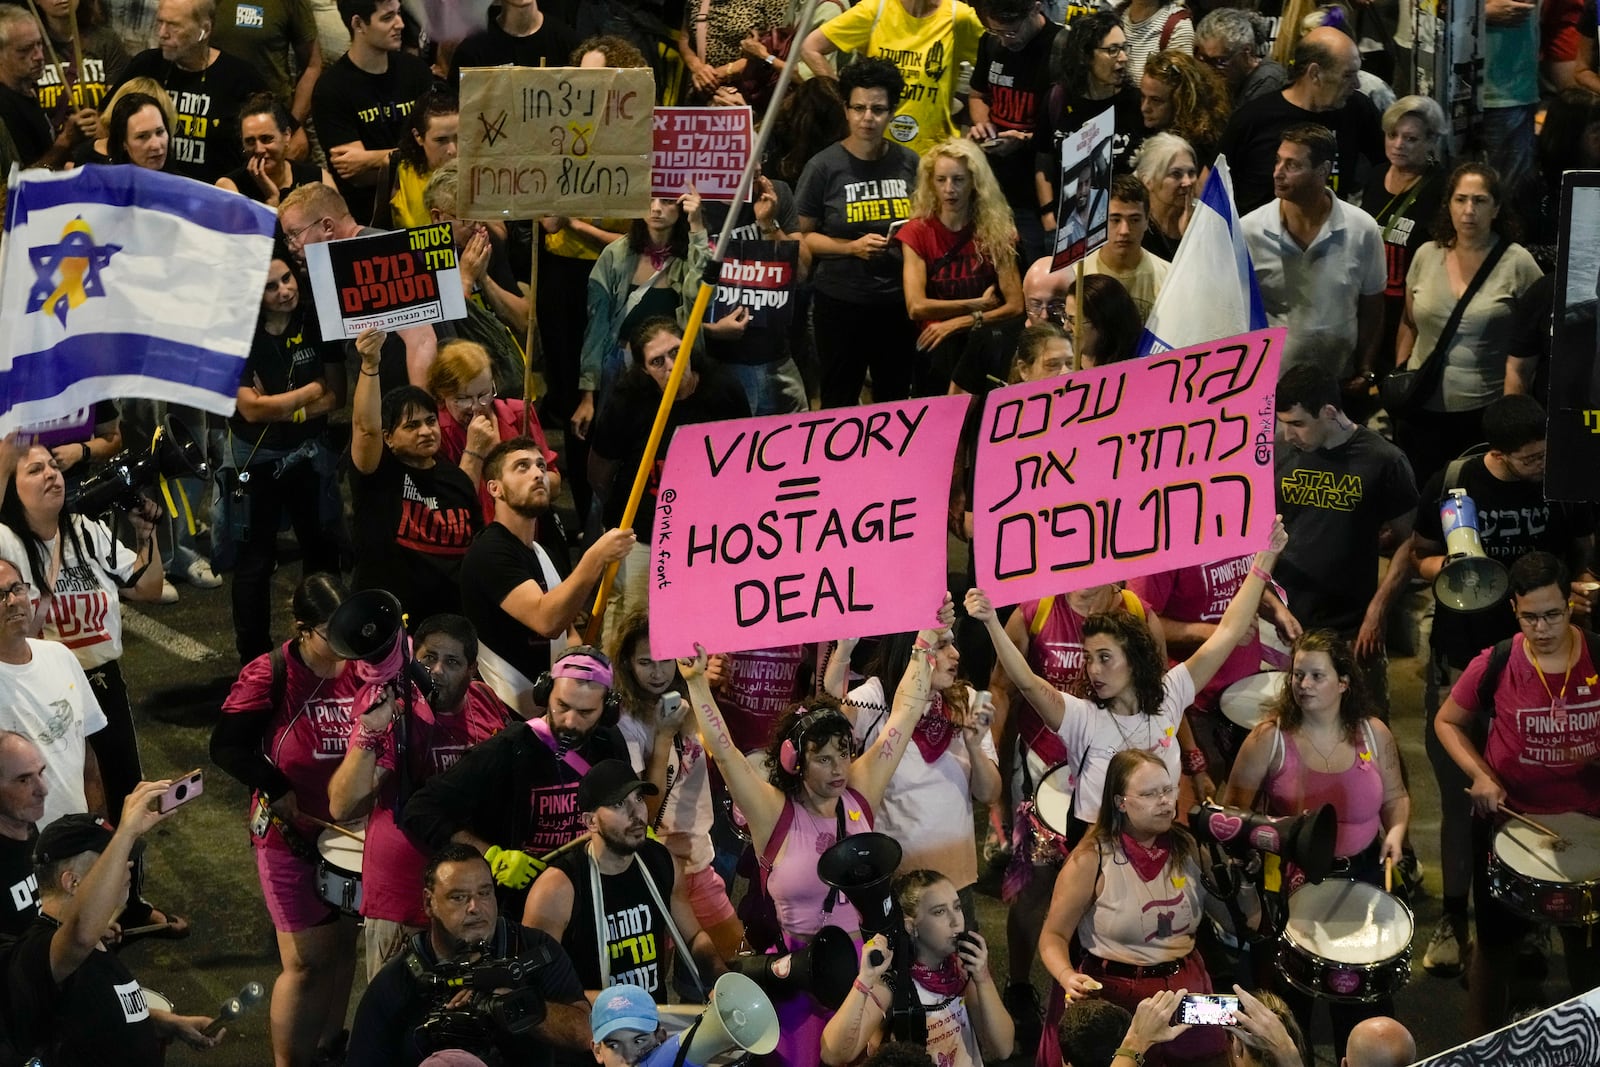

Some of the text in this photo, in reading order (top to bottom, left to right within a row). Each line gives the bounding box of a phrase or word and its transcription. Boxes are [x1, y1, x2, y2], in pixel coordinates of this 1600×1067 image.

[523, 81, 638, 126] אין ניצחון
[652, 115, 746, 132] עוצרות א
[550, 126, 591, 157] עד
[677, 132, 746, 151] העולם
[470, 158, 630, 205] החטוף האחרון
[652, 172, 685, 188] שם
[844, 181, 879, 202] בבית
[409, 223, 452, 250] עסקה
[353, 252, 415, 286] כולנו
[425, 249, 455, 271] מידי!
[721, 259, 783, 283] די למלח
[342, 274, 435, 313] חטופים
[742, 289, 789, 310] עסקה
[387, 312, 420, 325] מנצחים
[422, 308, 436, 317] אין
[990, 337, 1274, 443] נגזר עליכם
[704, 404, 929, 478] VICTORY
[989, 407, 1248, 513] להחזיר את
[1282, 468, 1362, 496] STAM
[1282, 485, 1362, 512] WARS
[687, 496, 918, 568] HOSTAGE
[995, 475, 1251, 580] החטופים
[734, 566, 875, 628] DEAL
[617, 904, 653, 938] למה
[608, 933, 658, 964] עדיי
